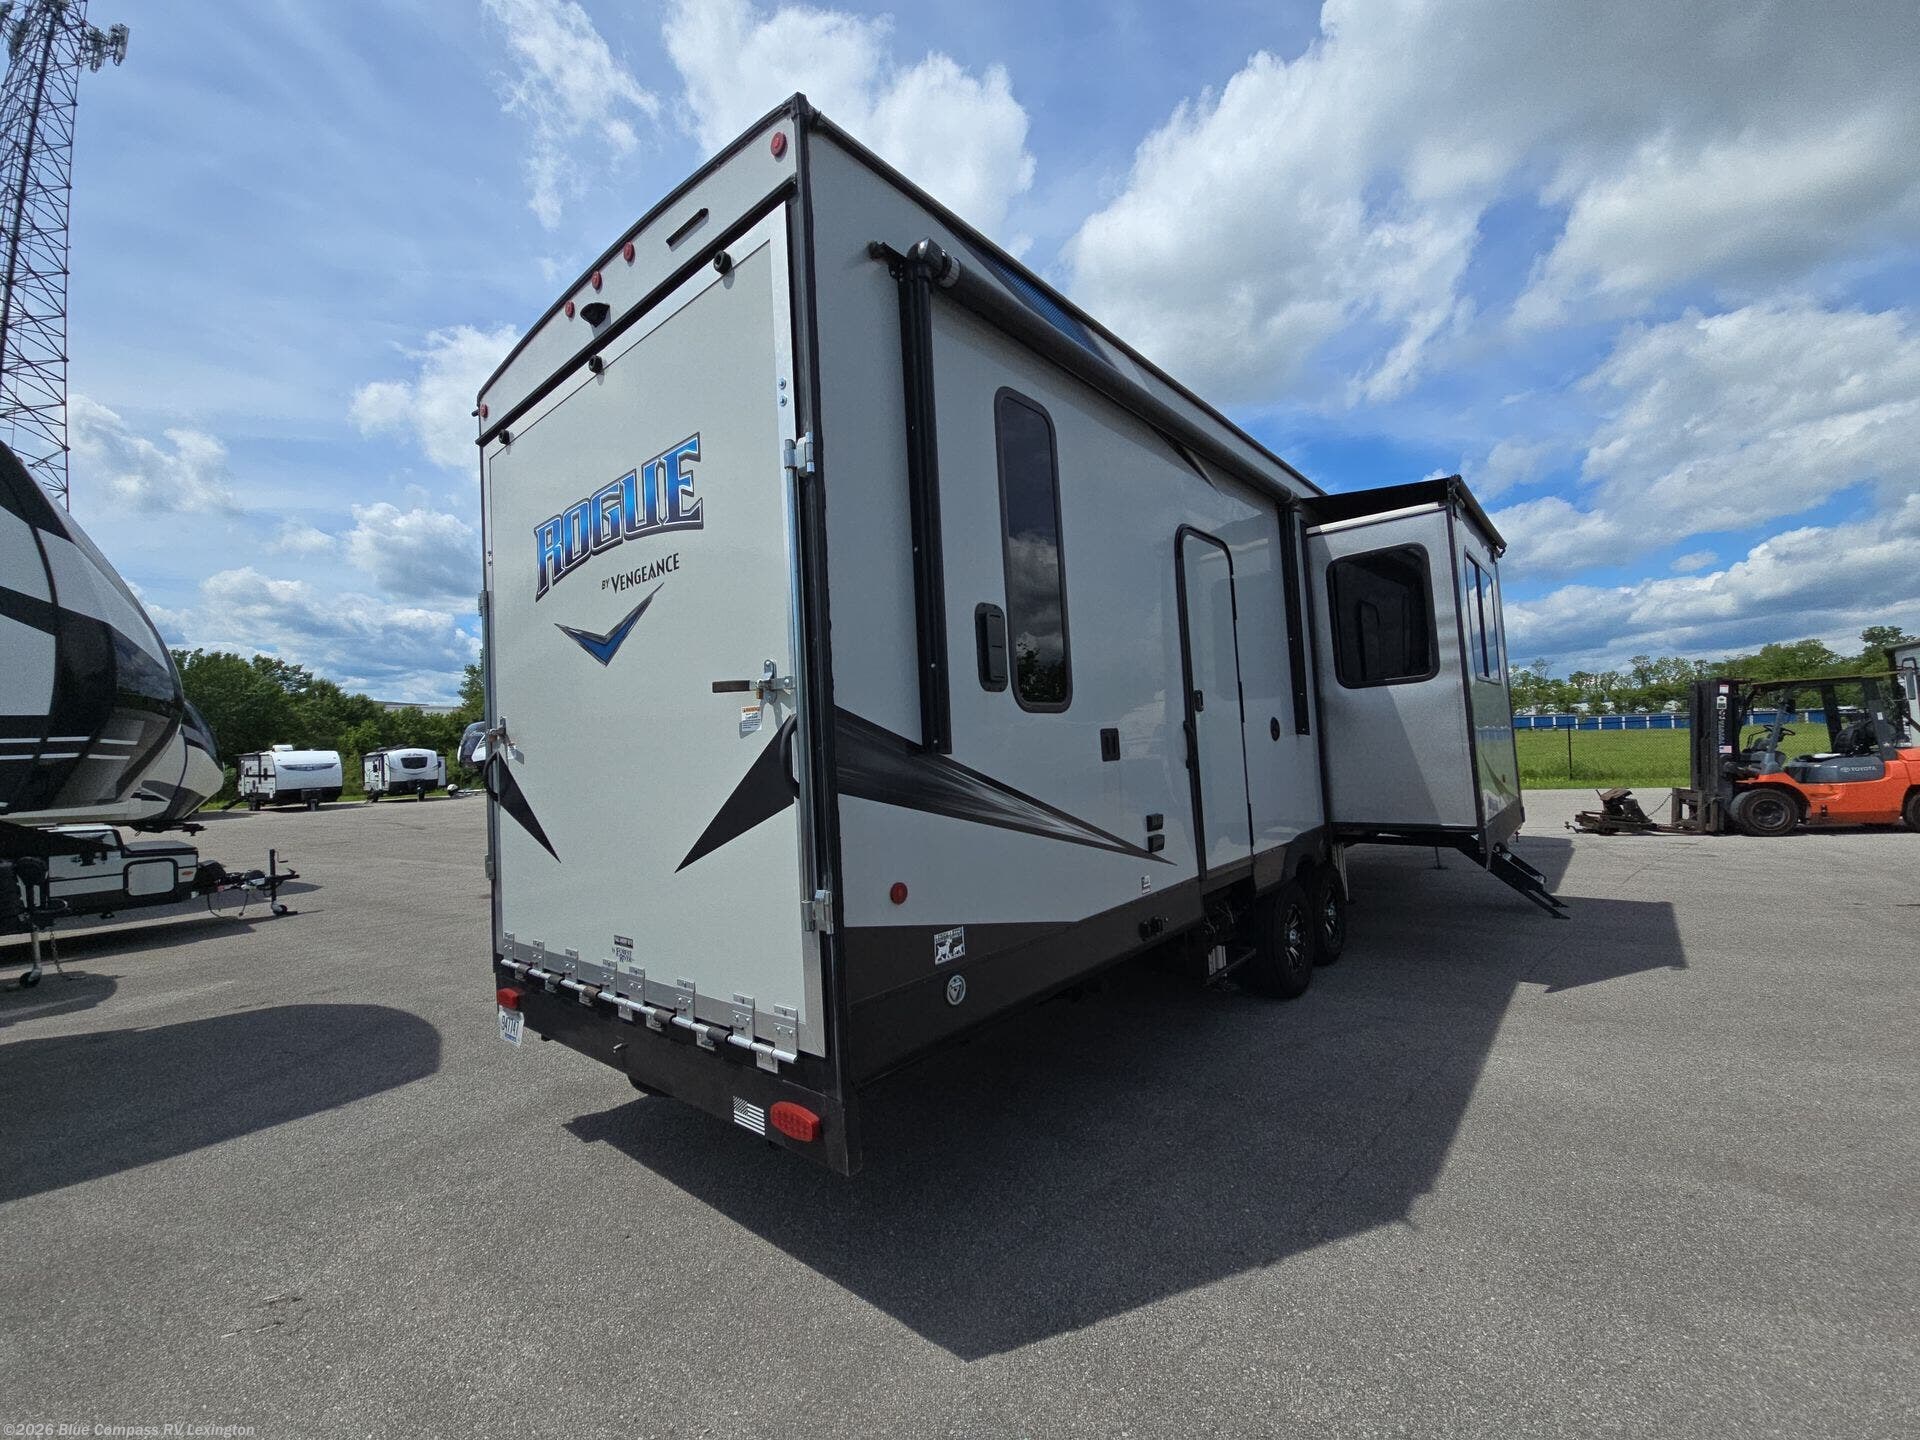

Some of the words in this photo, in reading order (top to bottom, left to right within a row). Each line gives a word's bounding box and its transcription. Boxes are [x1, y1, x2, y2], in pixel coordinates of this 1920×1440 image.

[534, 431, 704, 603] ROGUE
[601, 577, 610, 590] BY
[611, 552, 680, 594] VENGEANCE
